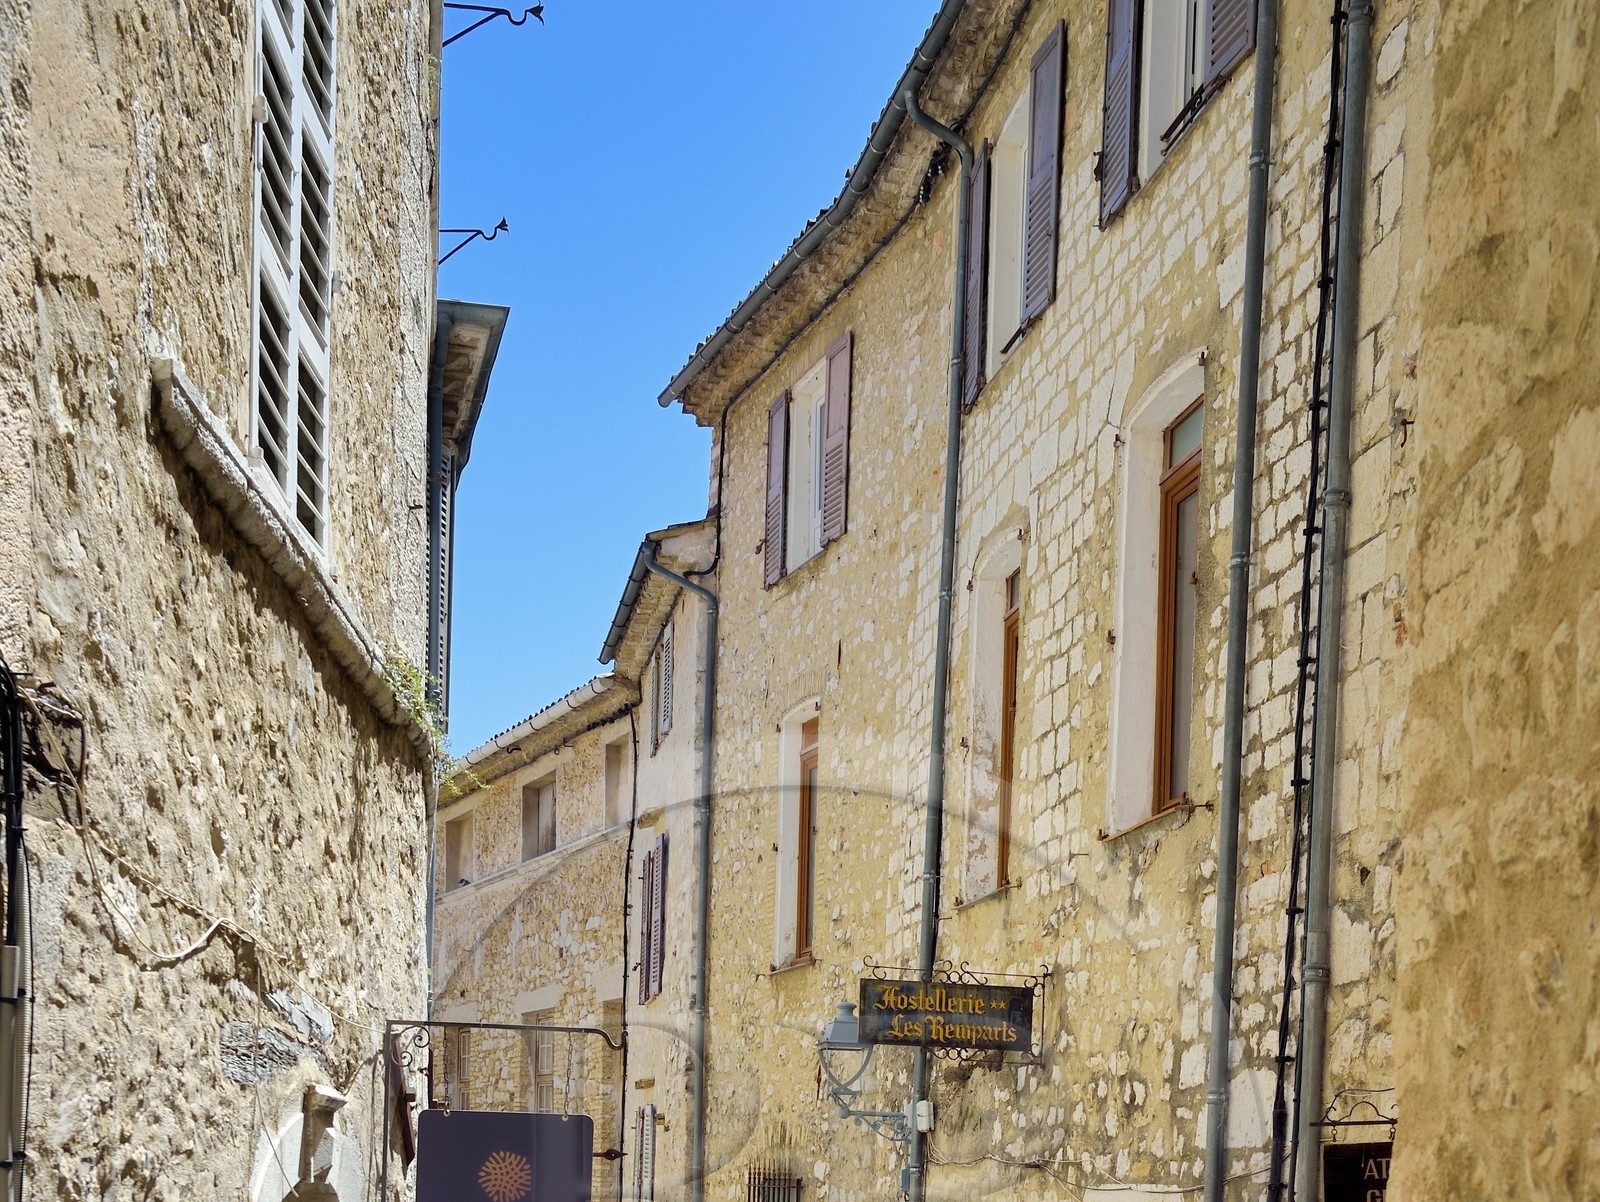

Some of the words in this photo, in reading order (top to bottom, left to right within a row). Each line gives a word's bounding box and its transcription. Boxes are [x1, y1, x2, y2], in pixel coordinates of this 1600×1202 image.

[873, 985, 987, 1015] Hostellerie
[886, 1013, 923, 1038] Les
[924, 1015, 1019, 1045] Remparts
